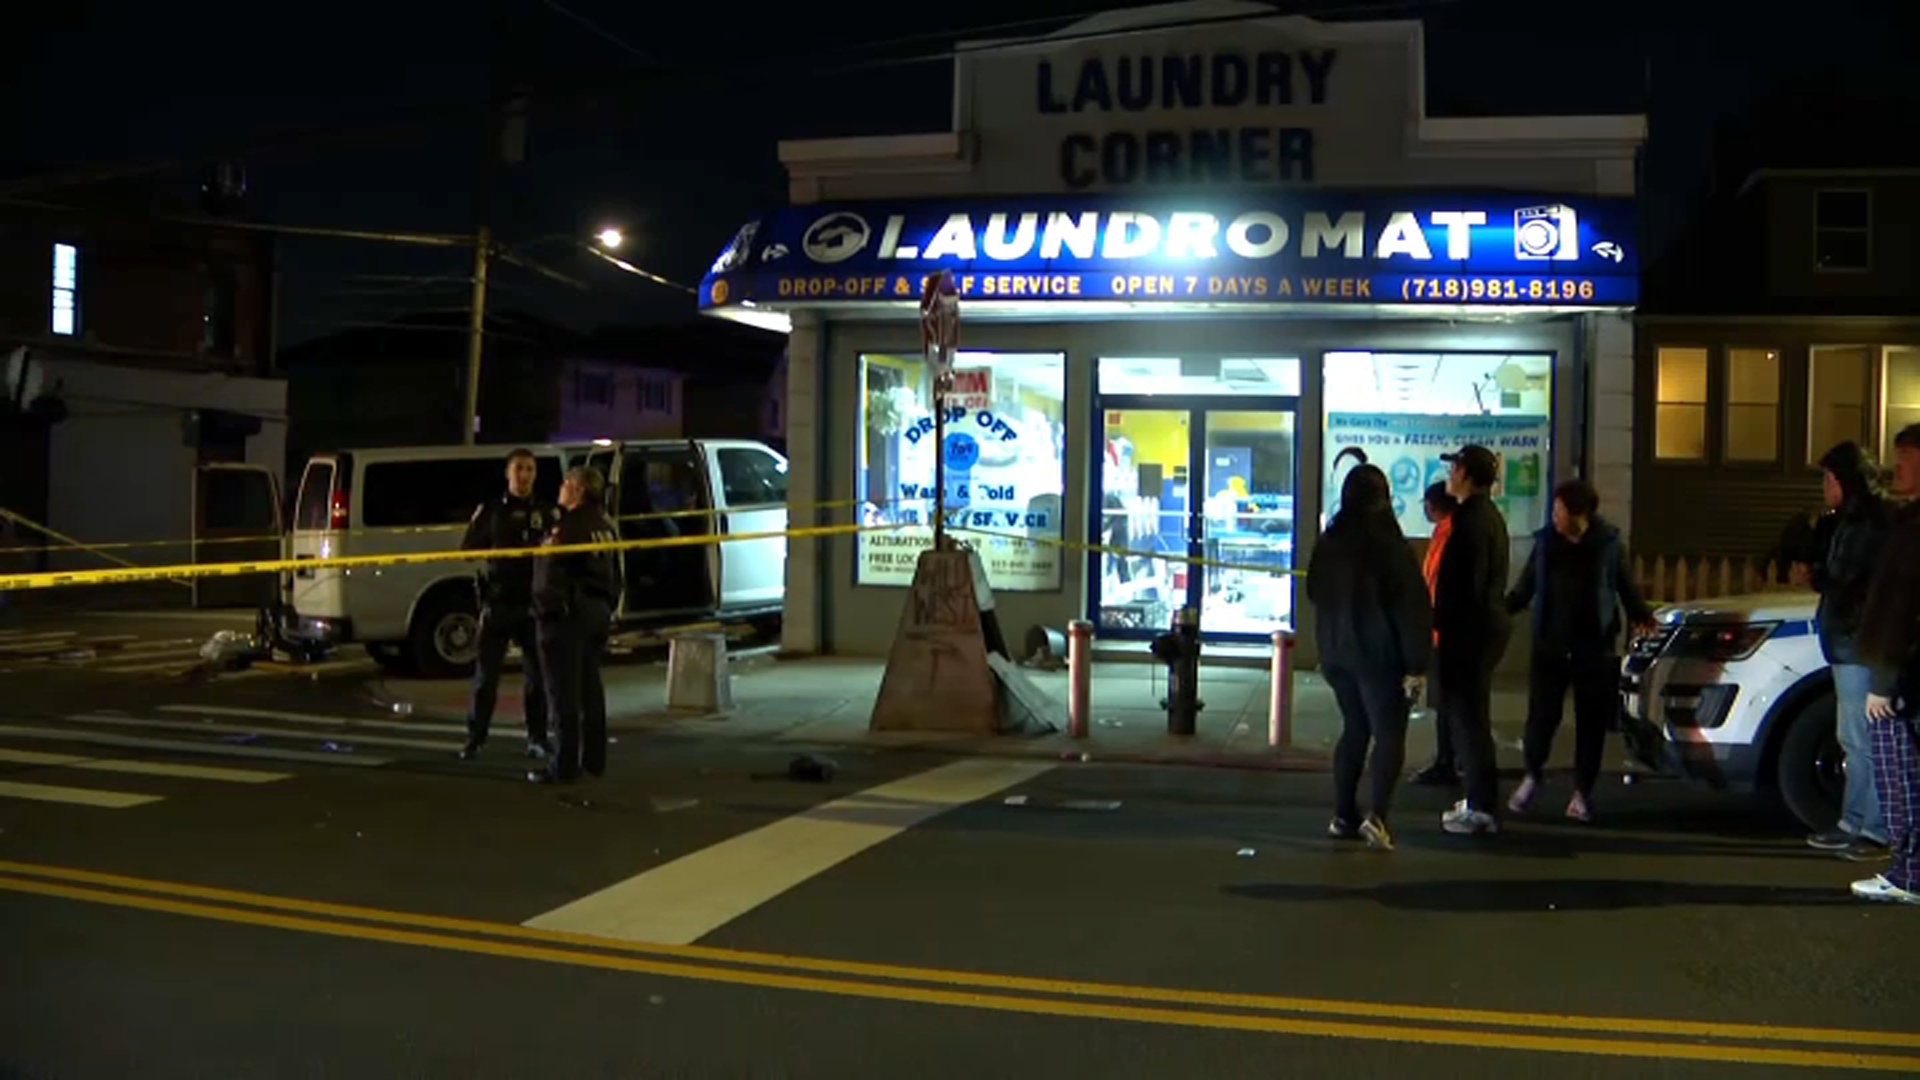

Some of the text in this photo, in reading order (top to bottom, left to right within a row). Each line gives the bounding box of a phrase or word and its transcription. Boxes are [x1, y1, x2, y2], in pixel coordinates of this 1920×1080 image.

[1037, 48, 1335, 114] LAUNDRY
[1061, 127, 1314, 188] CORNER
[878, 211, 1486, 261] LAUNDROMAT
[778, 276, 1595, 301] DROP-OFF & SF SERVICE OPEN 7 DAYS A WEEK (718)981-8196
[976, 410, 1018, 442] OFF
[957, 485, 969, 498] &
